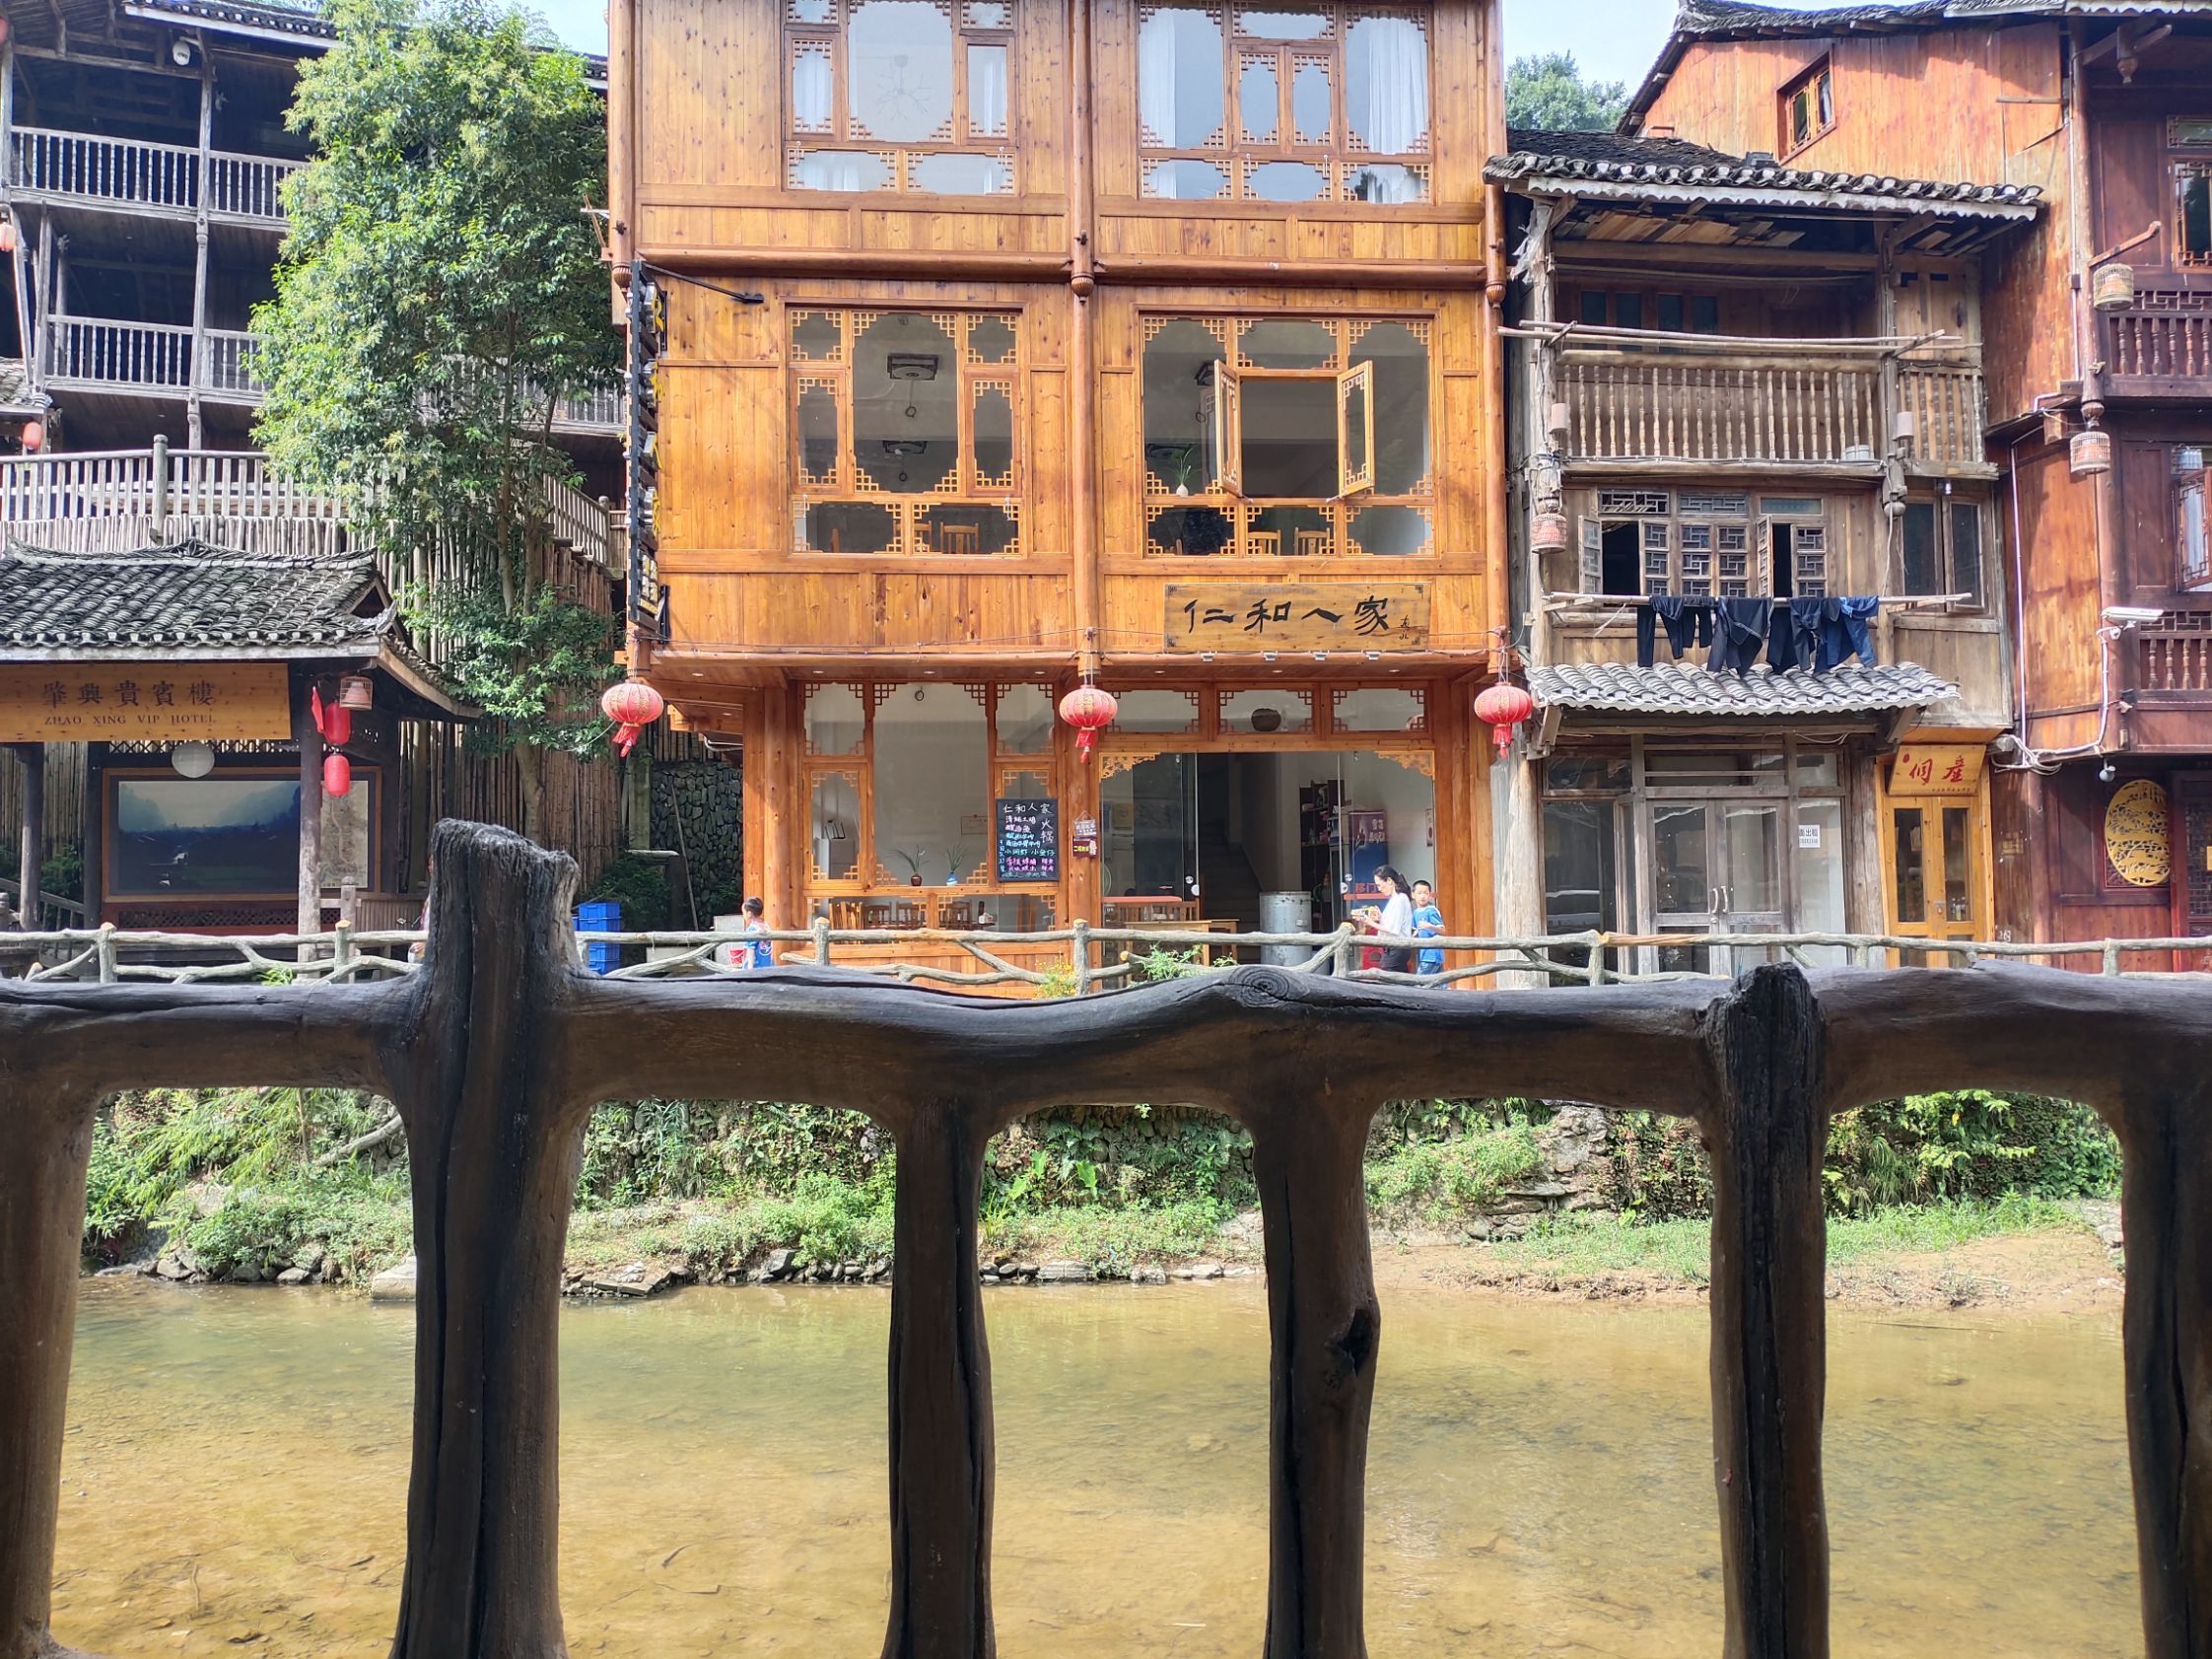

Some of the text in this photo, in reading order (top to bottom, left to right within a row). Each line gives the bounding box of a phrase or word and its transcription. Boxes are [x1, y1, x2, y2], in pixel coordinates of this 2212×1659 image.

[1184, 594, 1391, 636] 仁和人家
[44, 715, 216, 726] ZHAO XING VIP HOTEL
[1002, 802, 1053, 814] 仁和人家
